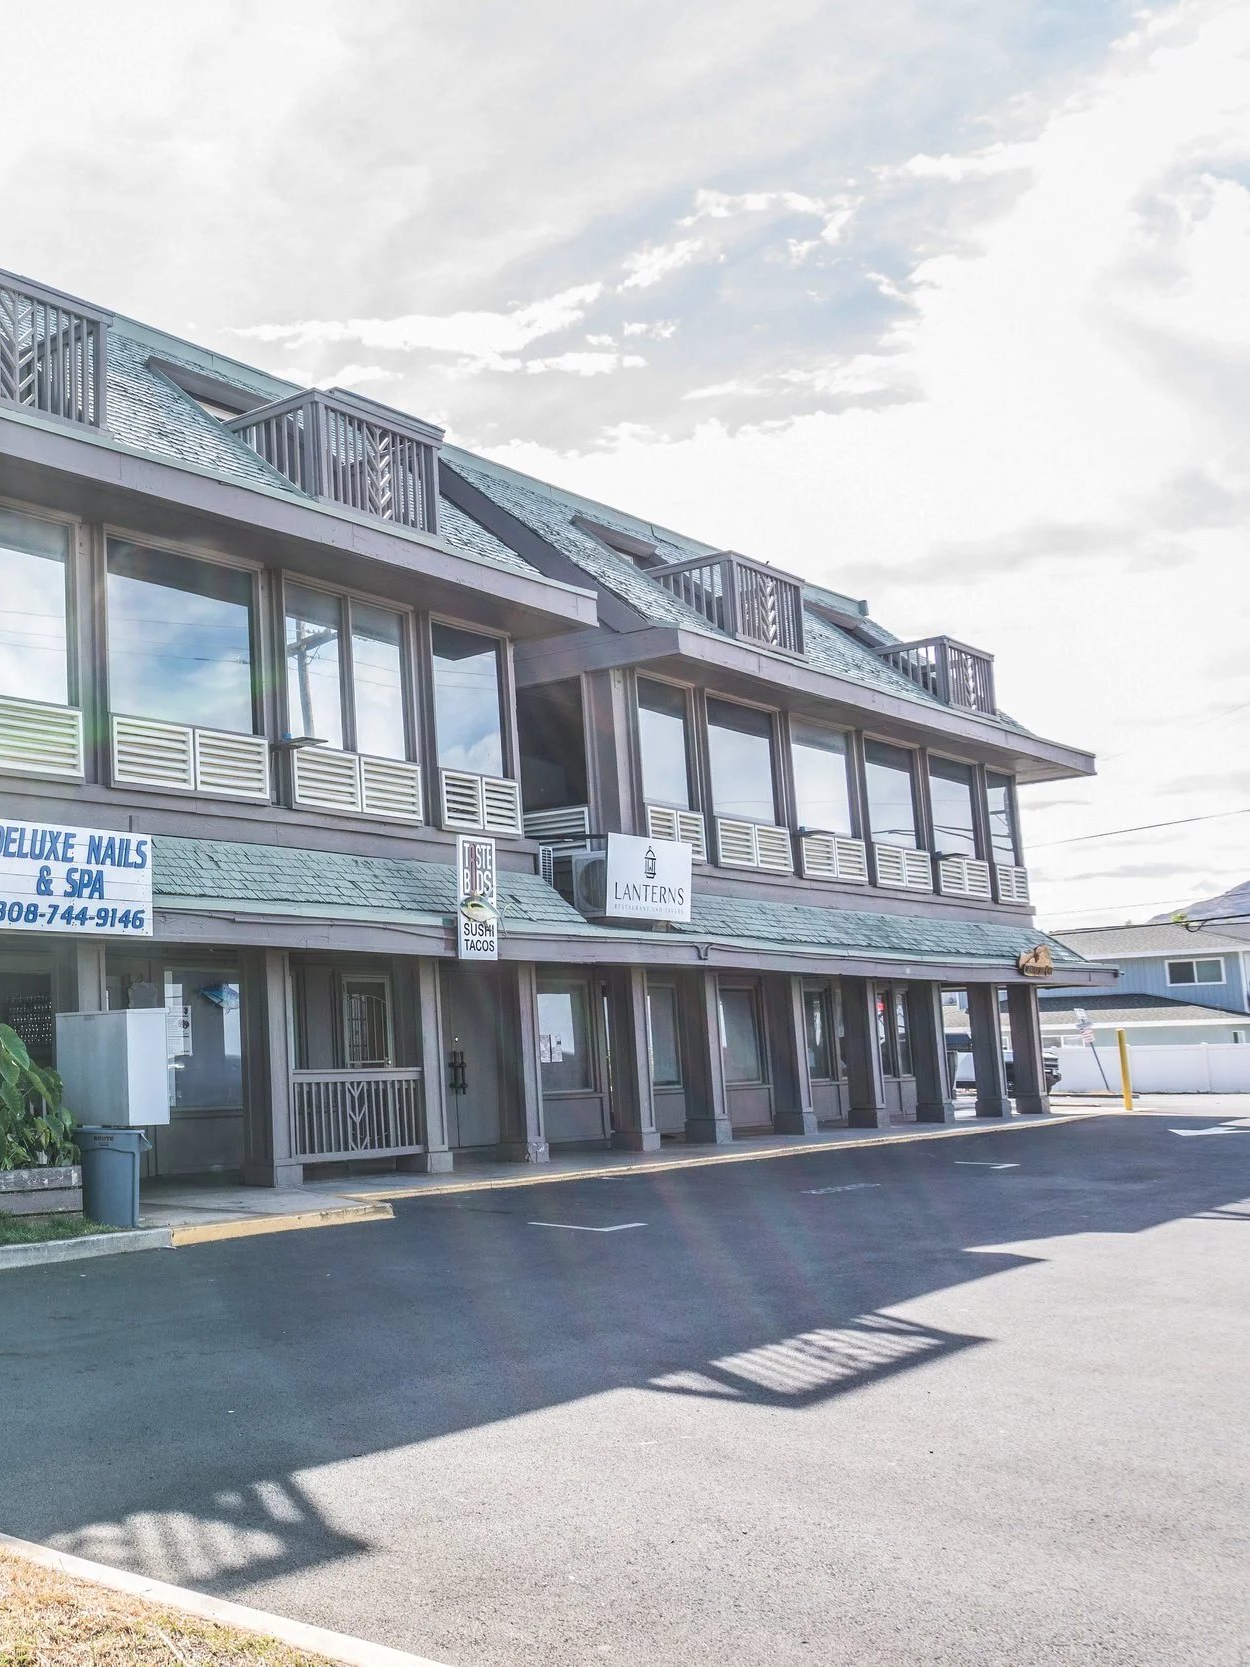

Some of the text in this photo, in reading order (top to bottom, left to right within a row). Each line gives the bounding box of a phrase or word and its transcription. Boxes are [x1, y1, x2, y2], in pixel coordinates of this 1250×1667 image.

[87, 834, 148, 870] NAILS
[463, 842, 492, 870] TASTE
[36, 865, 105, 900] & SPA
[615, 881, 684, 906] LANTERNS
[614, 903, 650, 912] RESTAURANT
[463, 922, 495, 938] SUSHI
[464, 939, 495, 952] TACOS
